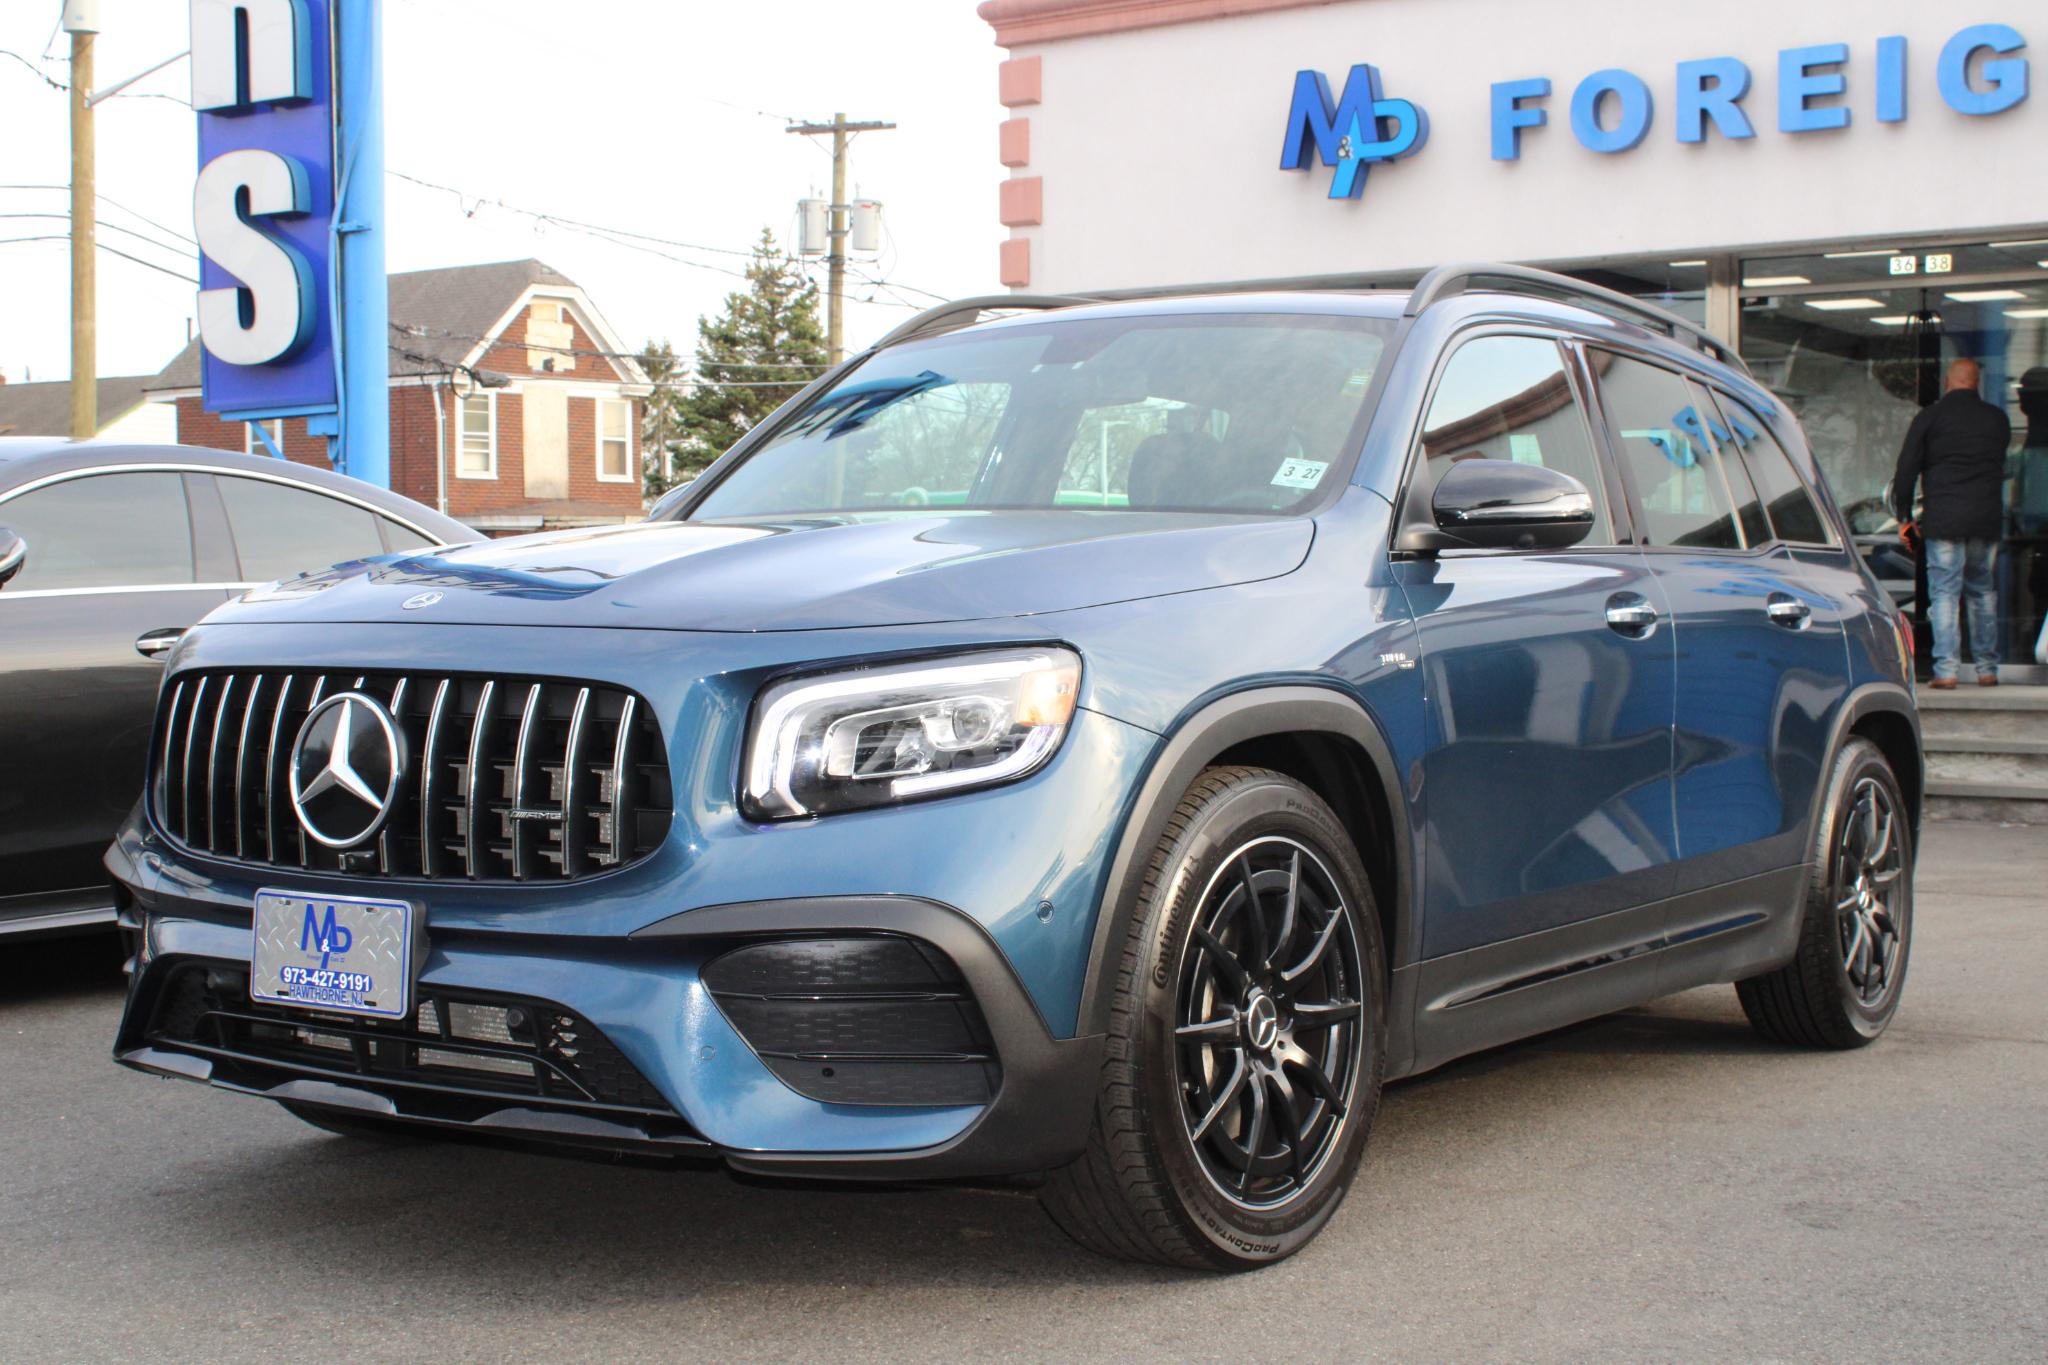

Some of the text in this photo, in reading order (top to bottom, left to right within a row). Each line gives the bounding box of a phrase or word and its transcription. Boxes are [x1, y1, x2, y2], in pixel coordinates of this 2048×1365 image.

[1490, 22, 2031, 161] FOREIG
[1893, 255, 1949, 273] 36 38
[1283, 466, 1321, 480] 3 27
[1152, 864, 1194, 990] Continental
[283, 966, 371, 993] 973-427-9191
[350, 990, 363, 1006] NJ
